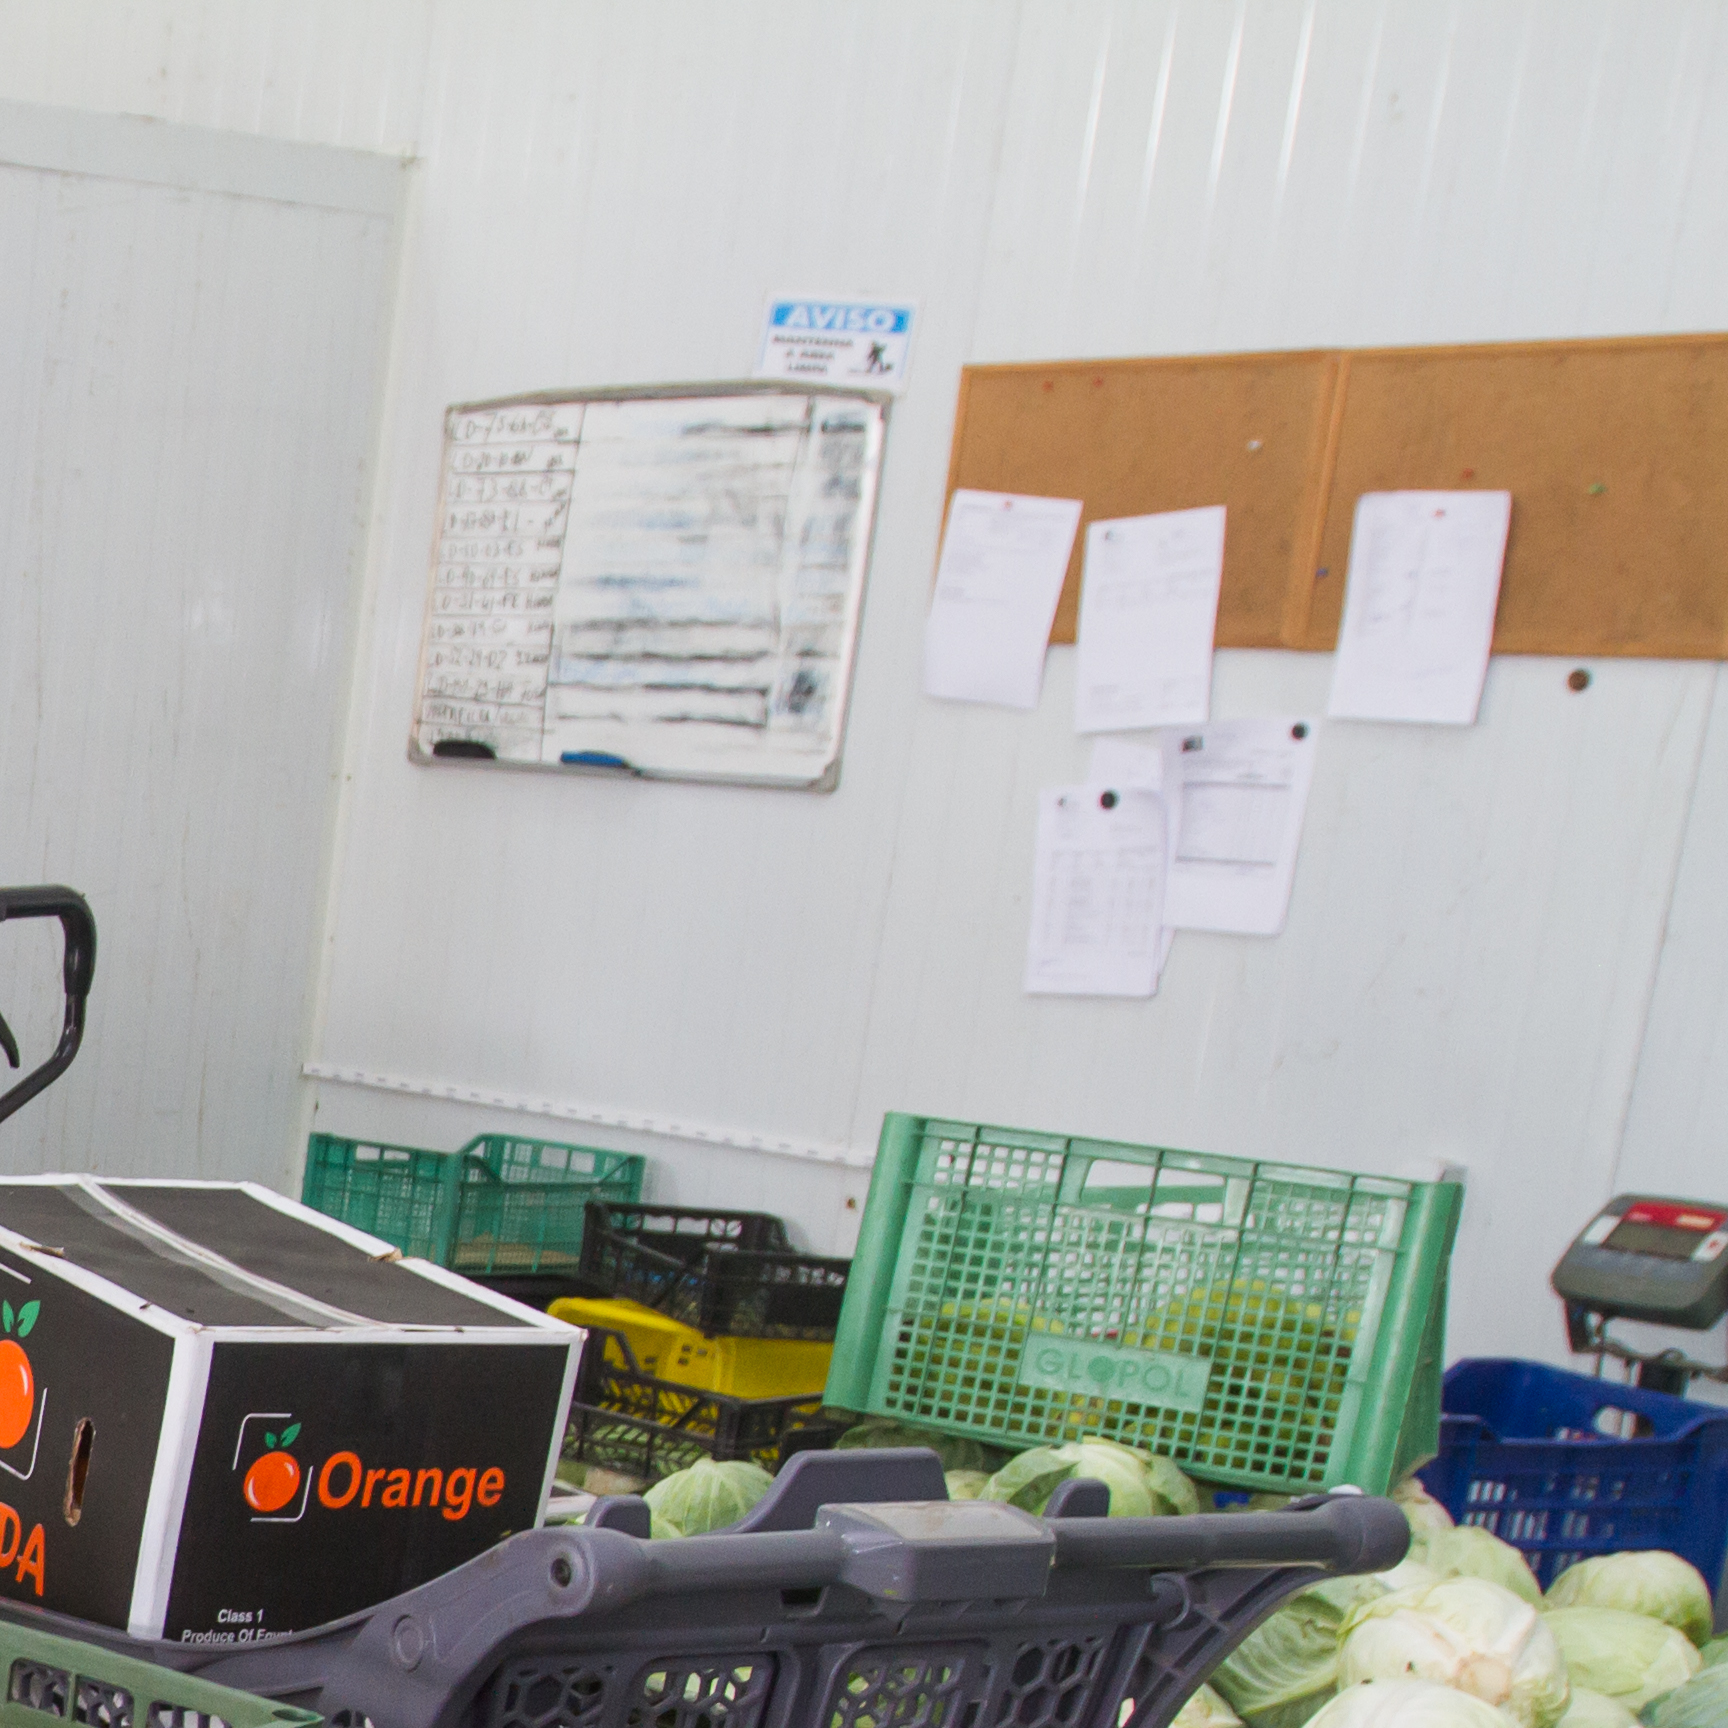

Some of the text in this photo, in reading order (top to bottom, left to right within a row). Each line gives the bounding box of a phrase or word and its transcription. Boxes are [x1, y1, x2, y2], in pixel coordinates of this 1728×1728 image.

[784, 304, 894, 331] AVISO
[318, 1450, 506, 1521] Orange
[218, 1608, 264, 1623] Class 1
[182, 1629, 235, 1644] Produce
[238, 1628, 255, 1643] Of
